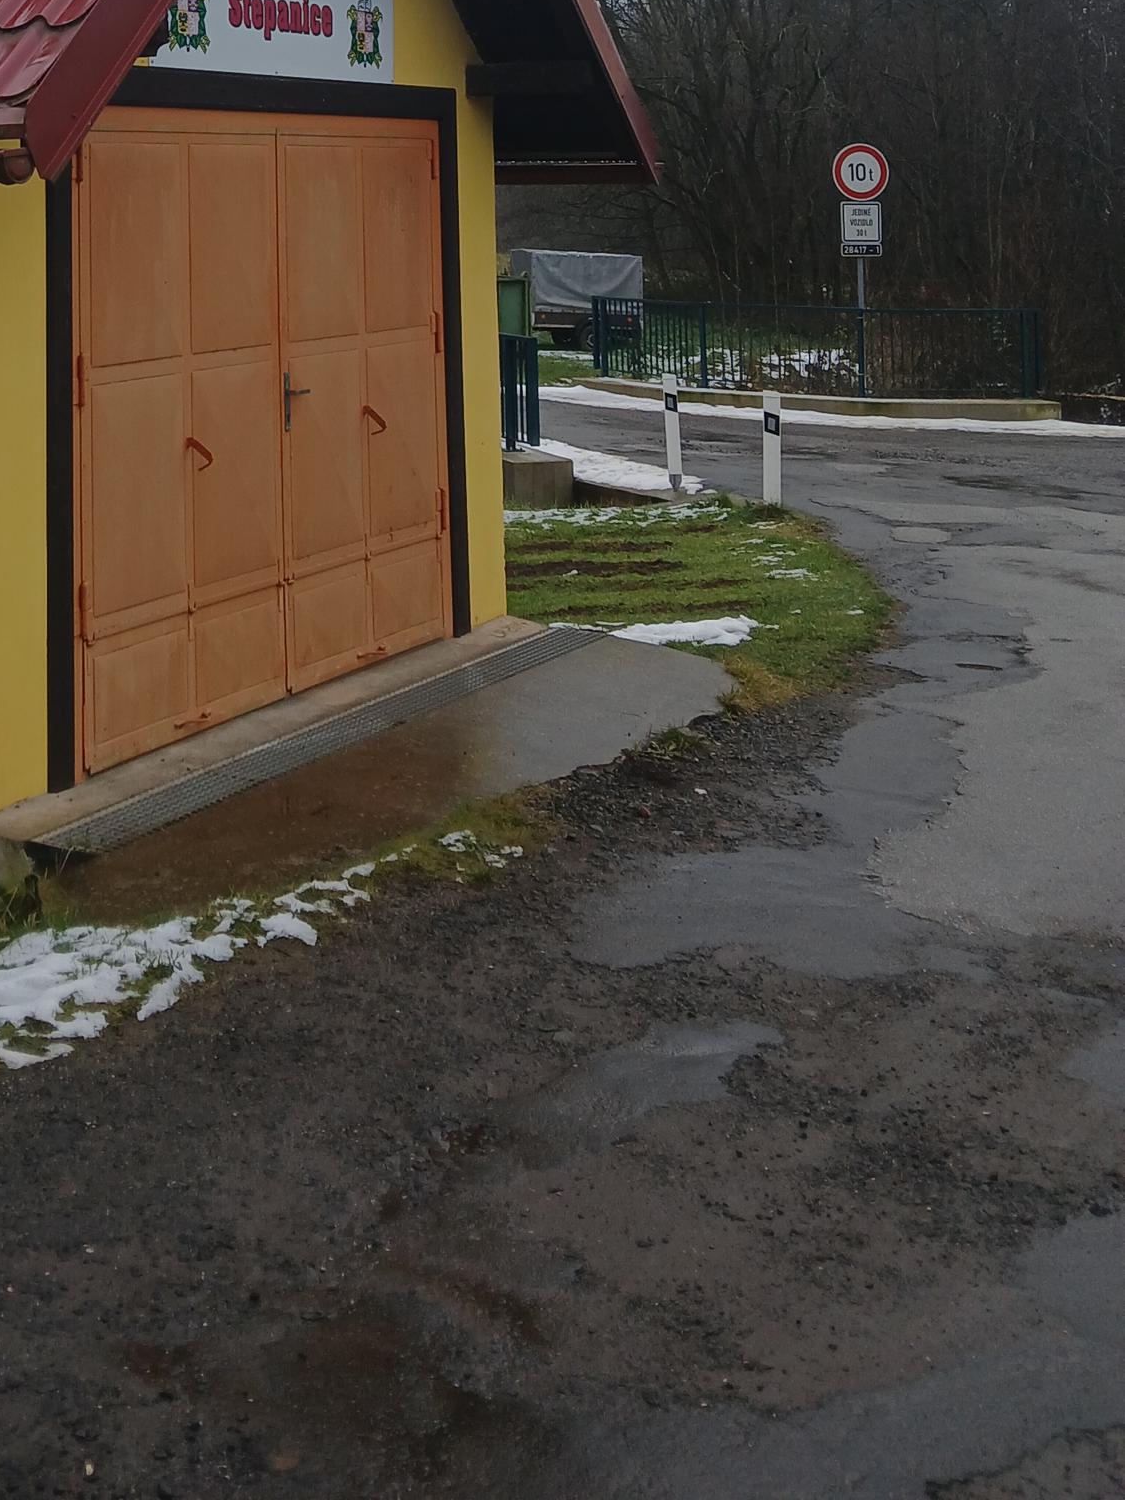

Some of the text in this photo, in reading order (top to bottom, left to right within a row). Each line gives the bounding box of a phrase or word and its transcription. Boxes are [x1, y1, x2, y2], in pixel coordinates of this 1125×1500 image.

[848, 163, 874, 181] 10 t
[851, 208, 871, 217] JEDINÉ
[850, 219, 873, 227] VOZIDLO
[844, 246, 867, 254] 28417
